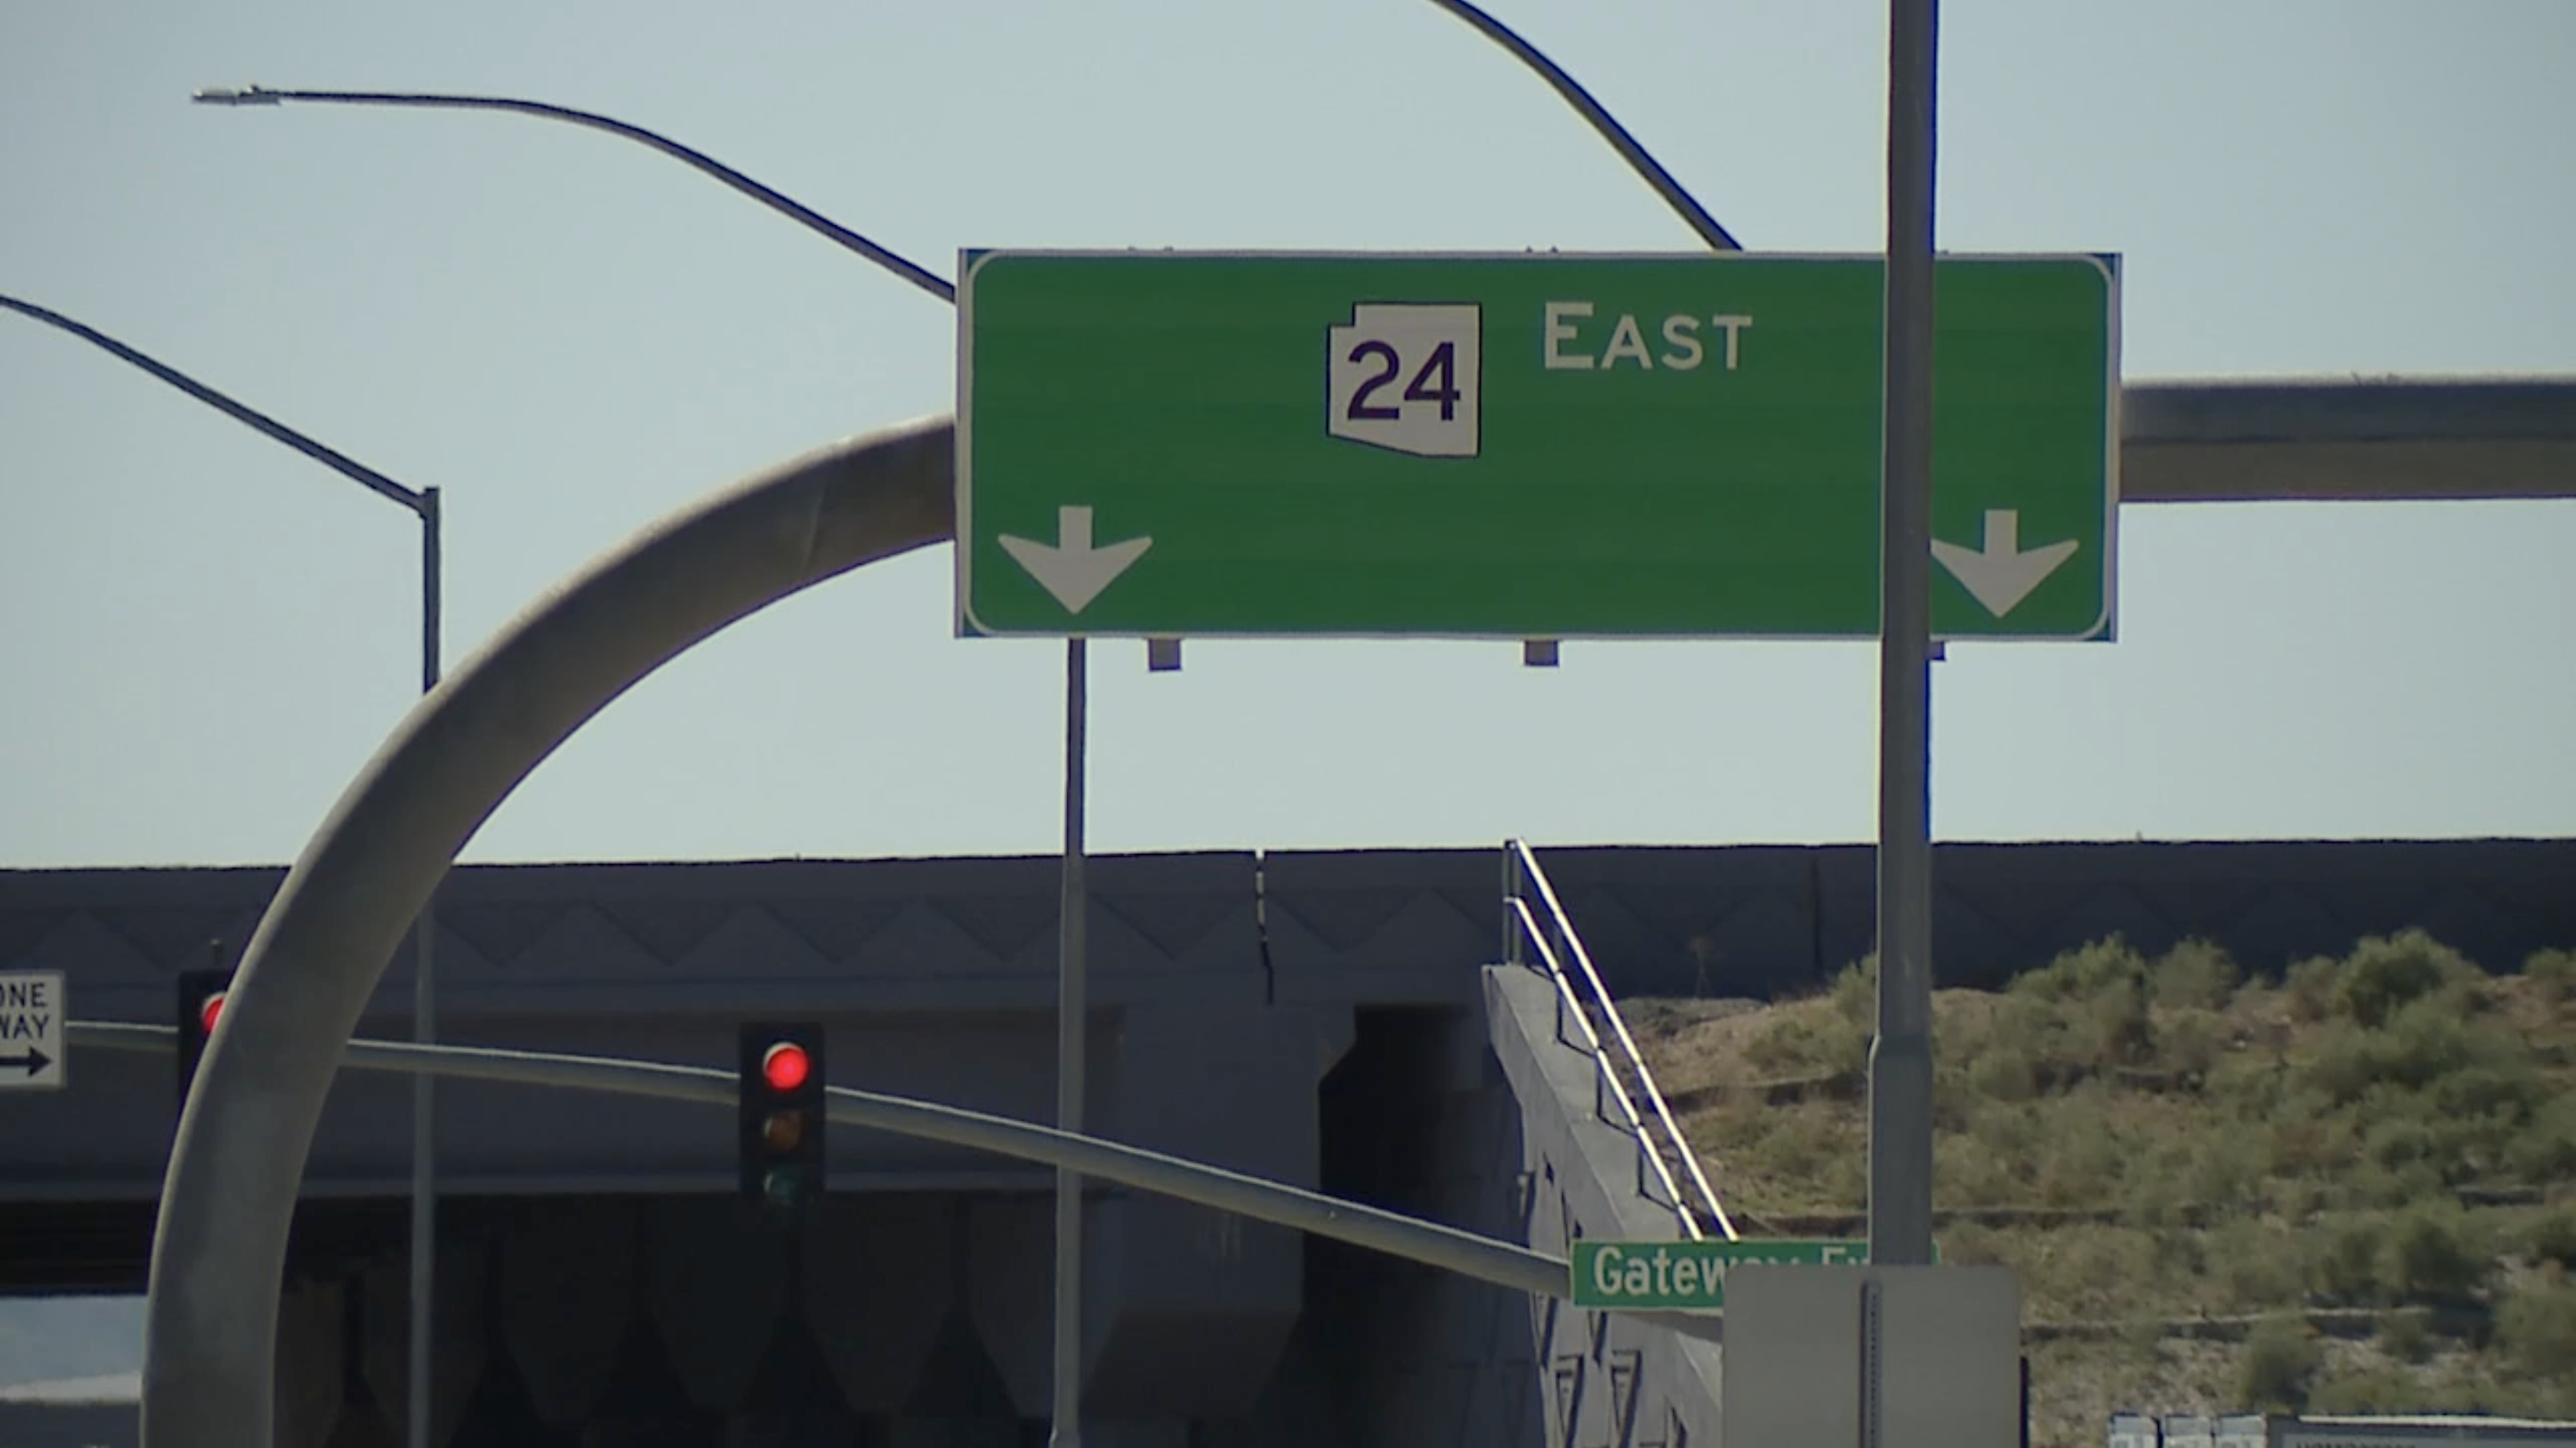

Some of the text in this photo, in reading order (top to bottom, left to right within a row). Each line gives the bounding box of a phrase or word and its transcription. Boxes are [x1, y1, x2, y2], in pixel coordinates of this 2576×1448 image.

[1347, 301, 1753, 421] 24 EAST
[1594, 1245, 1800, 1295] Gatew
